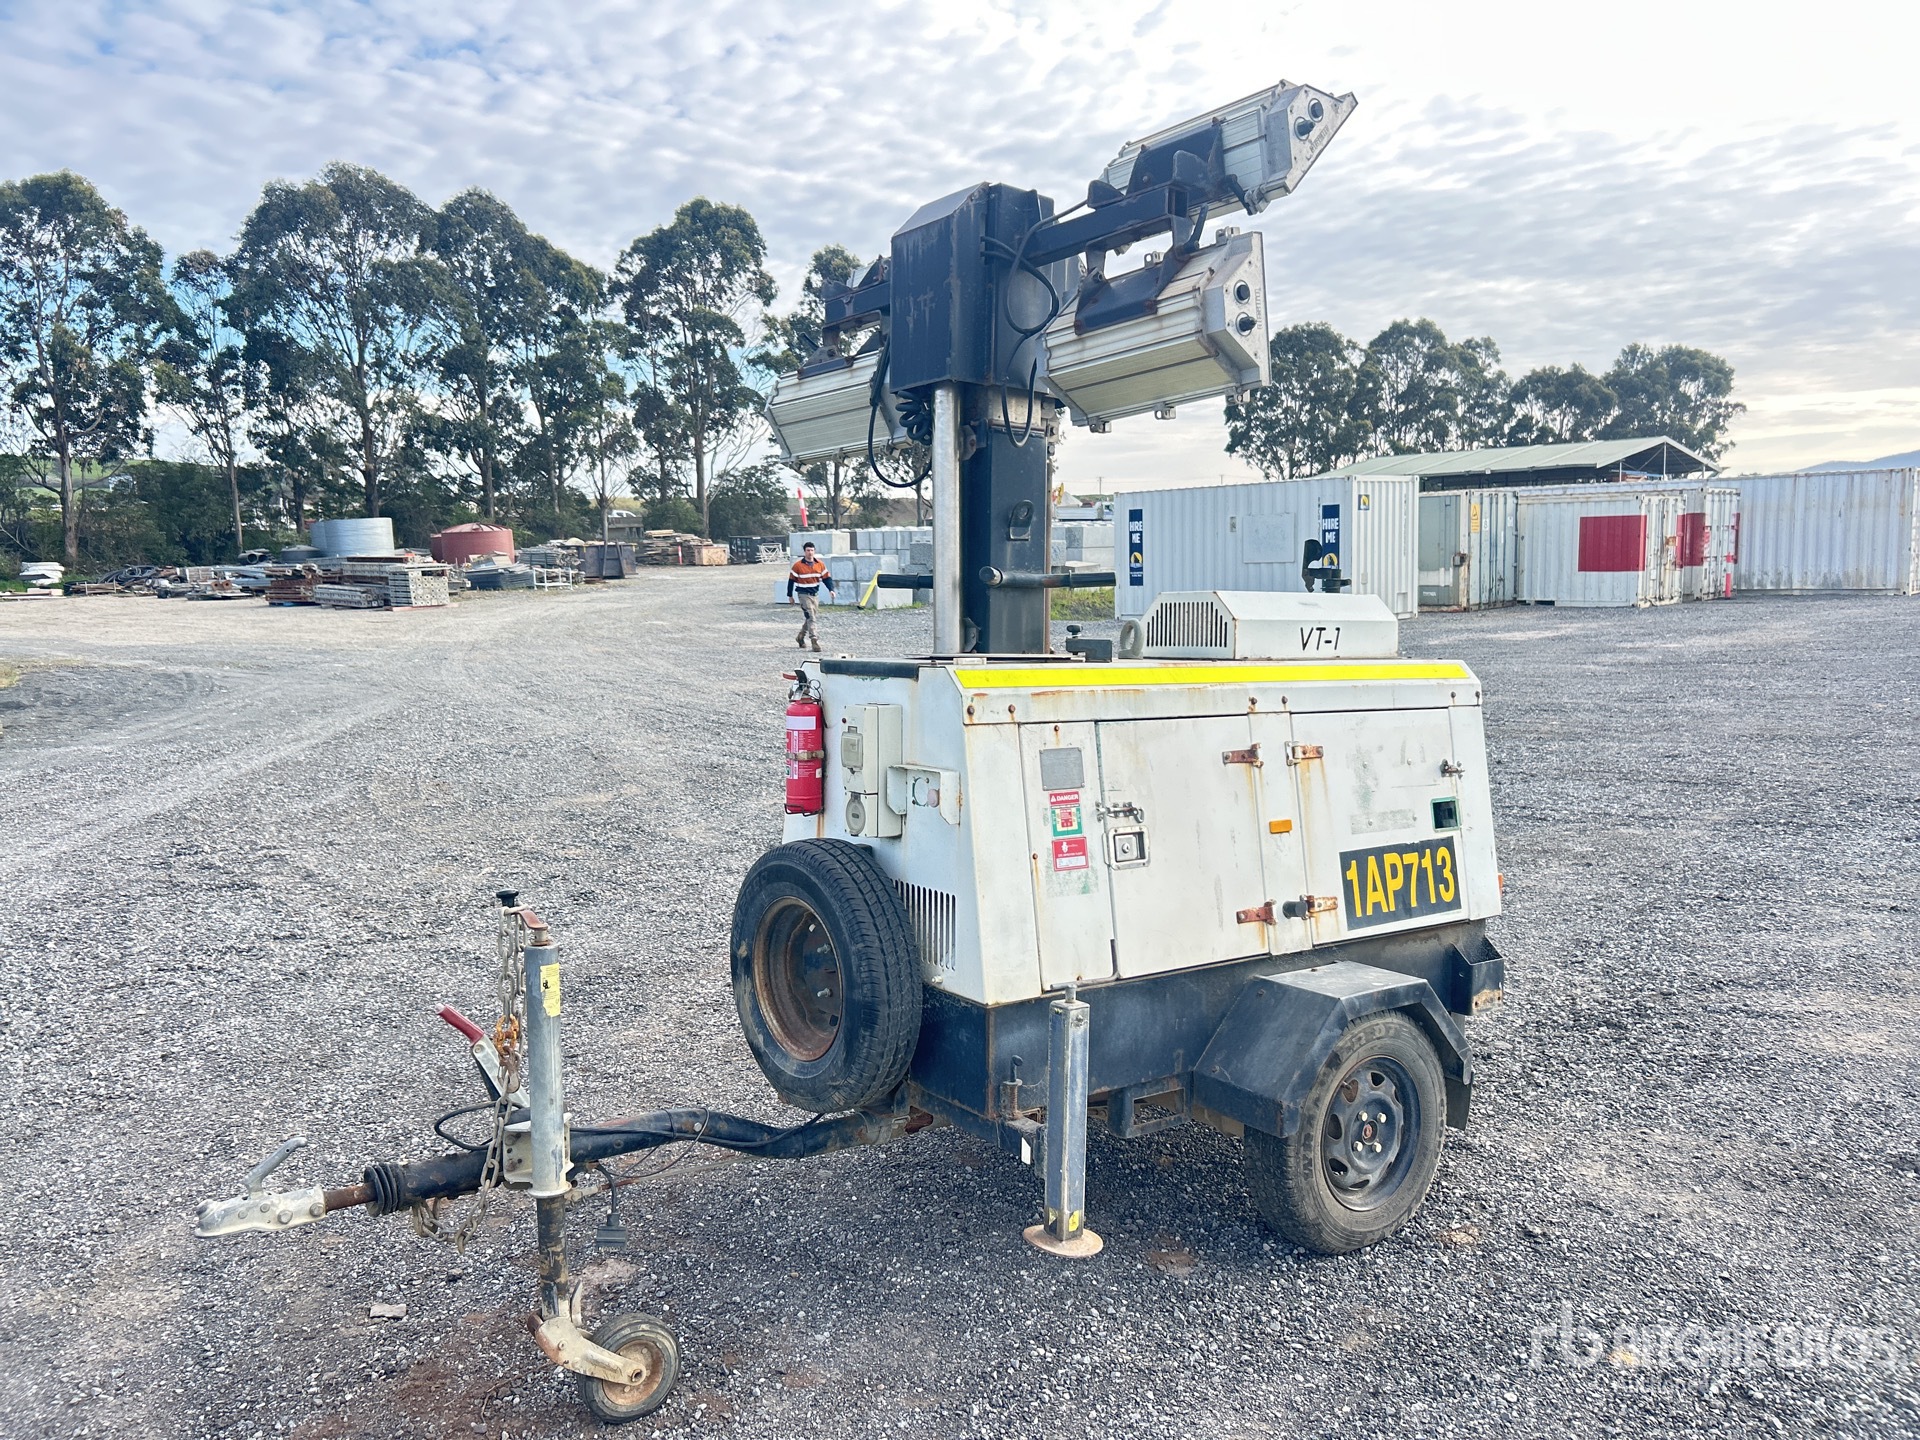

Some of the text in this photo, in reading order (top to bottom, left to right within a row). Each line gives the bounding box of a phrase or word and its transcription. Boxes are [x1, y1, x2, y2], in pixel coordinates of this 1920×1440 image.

[1129, 520, 1143, 532] HIRE
[1322, 517, 1339, 530] HIRE
[1132, 533, 1141, 543] ME
[1325, 531, 1336, 543] ME
[1300, 626, 1341, 651] VT-1
[1056, 793, 1079, 801] DANGER
[1346, 846, 1455, 918] 1AP713
